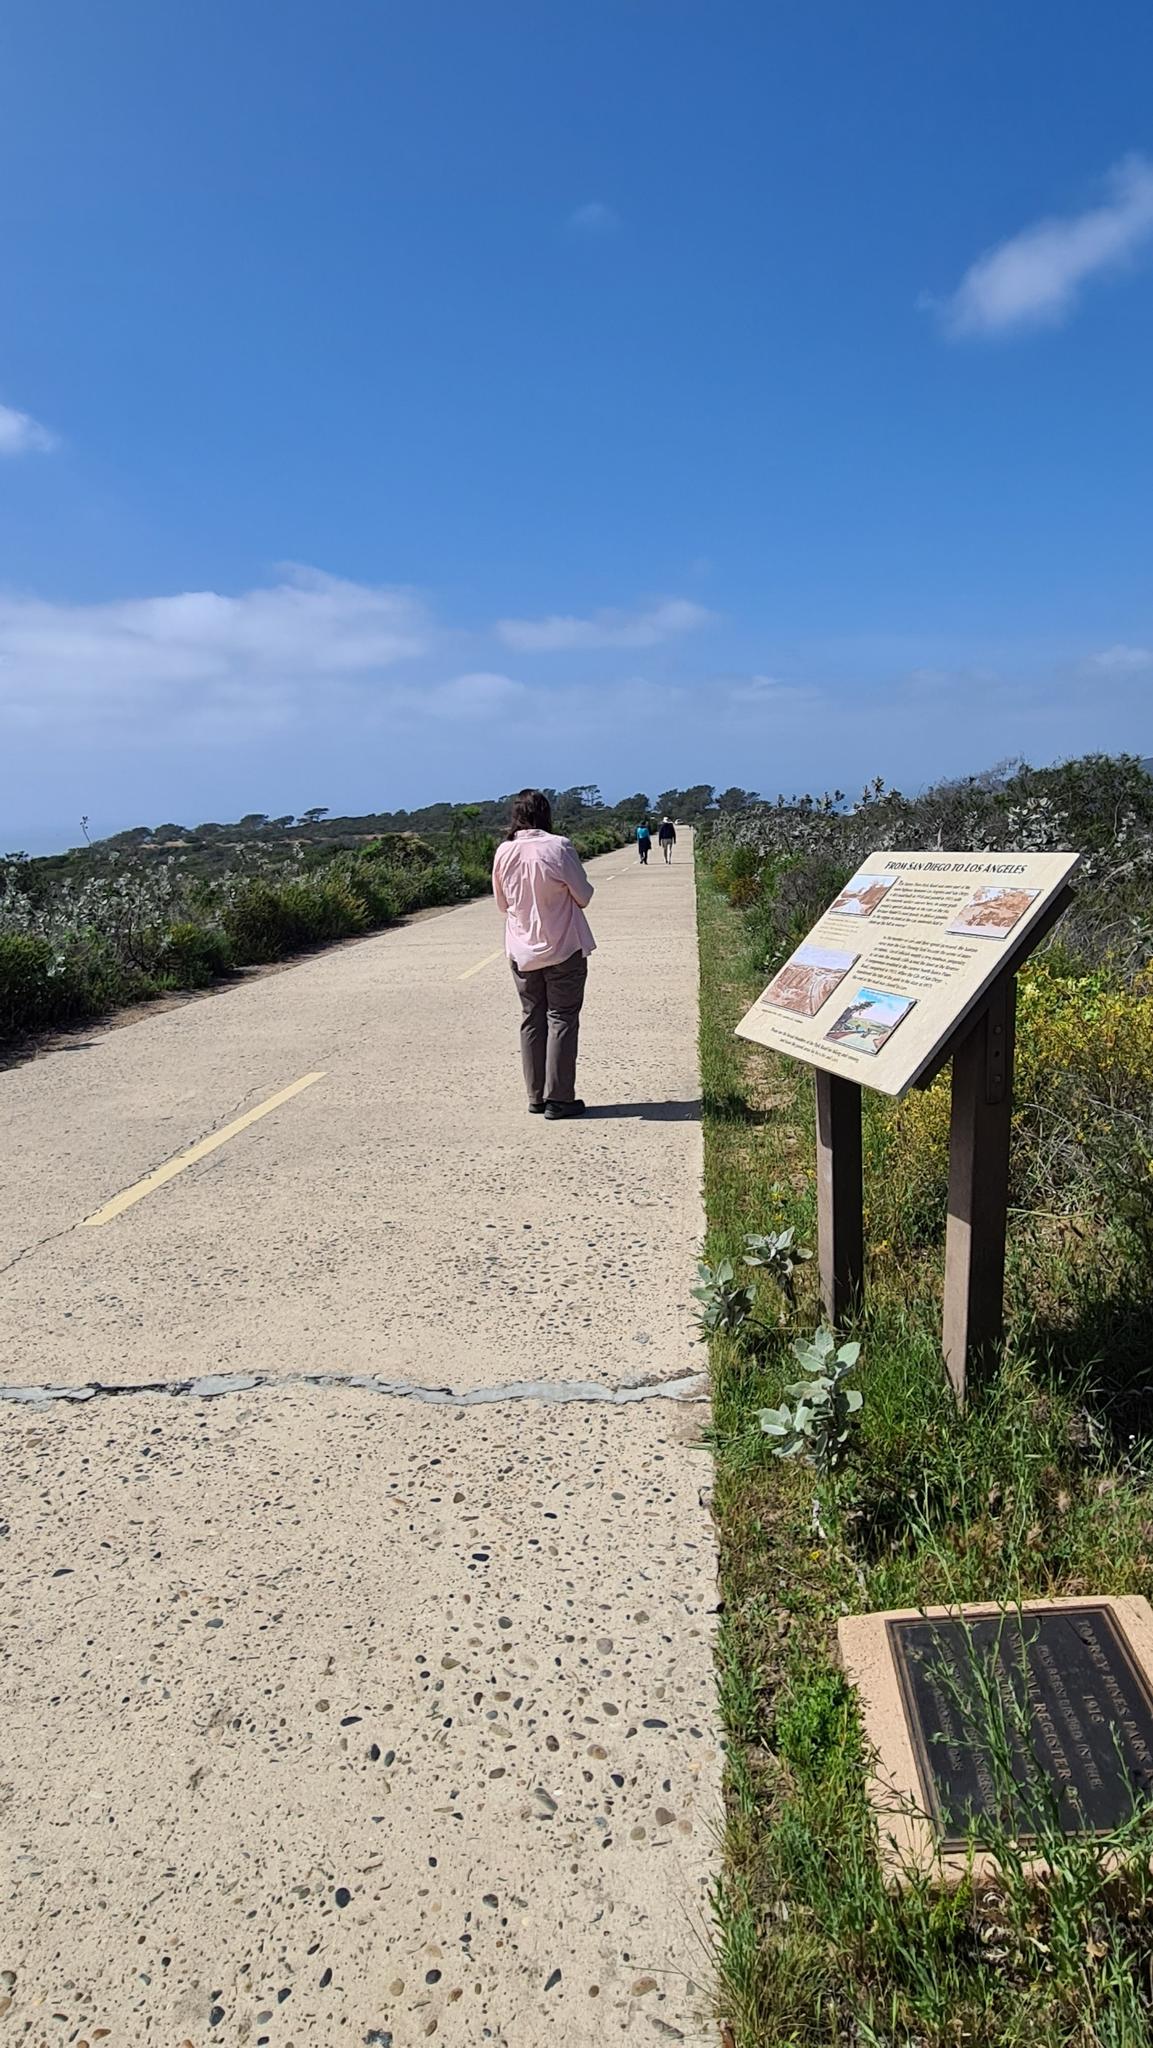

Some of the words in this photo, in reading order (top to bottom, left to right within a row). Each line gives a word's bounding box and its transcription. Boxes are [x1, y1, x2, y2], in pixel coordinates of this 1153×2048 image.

[884, 861, 906, 870] FROM
[906, 862, 923, 871] SAN
[923, 862, 951, 872] DIEGO
[951, 863, 964, 872] TO
[963, 863, 984, 873] LOS
[983, 864, 1028, 874] ANGELES
[1038, 1645, 1055, 1667] HAS
[1047, 1668, 1068, 1698] BEEN
[1078, 1619, 1111, 1671] TORREY
[1102, 1674, 1130, 1716] PINES
[1123, 1720, 1152, 1761] PARK
[1059, 1699, 1084, 1738] LISTED
[1082, 1695, 1105, 1722] 1915
[1033, 1703, 1072, 1780] REGISTER
[1077, 1742, 1092, 1759] IN
[1084, 1761, 1104, 1789] THE
